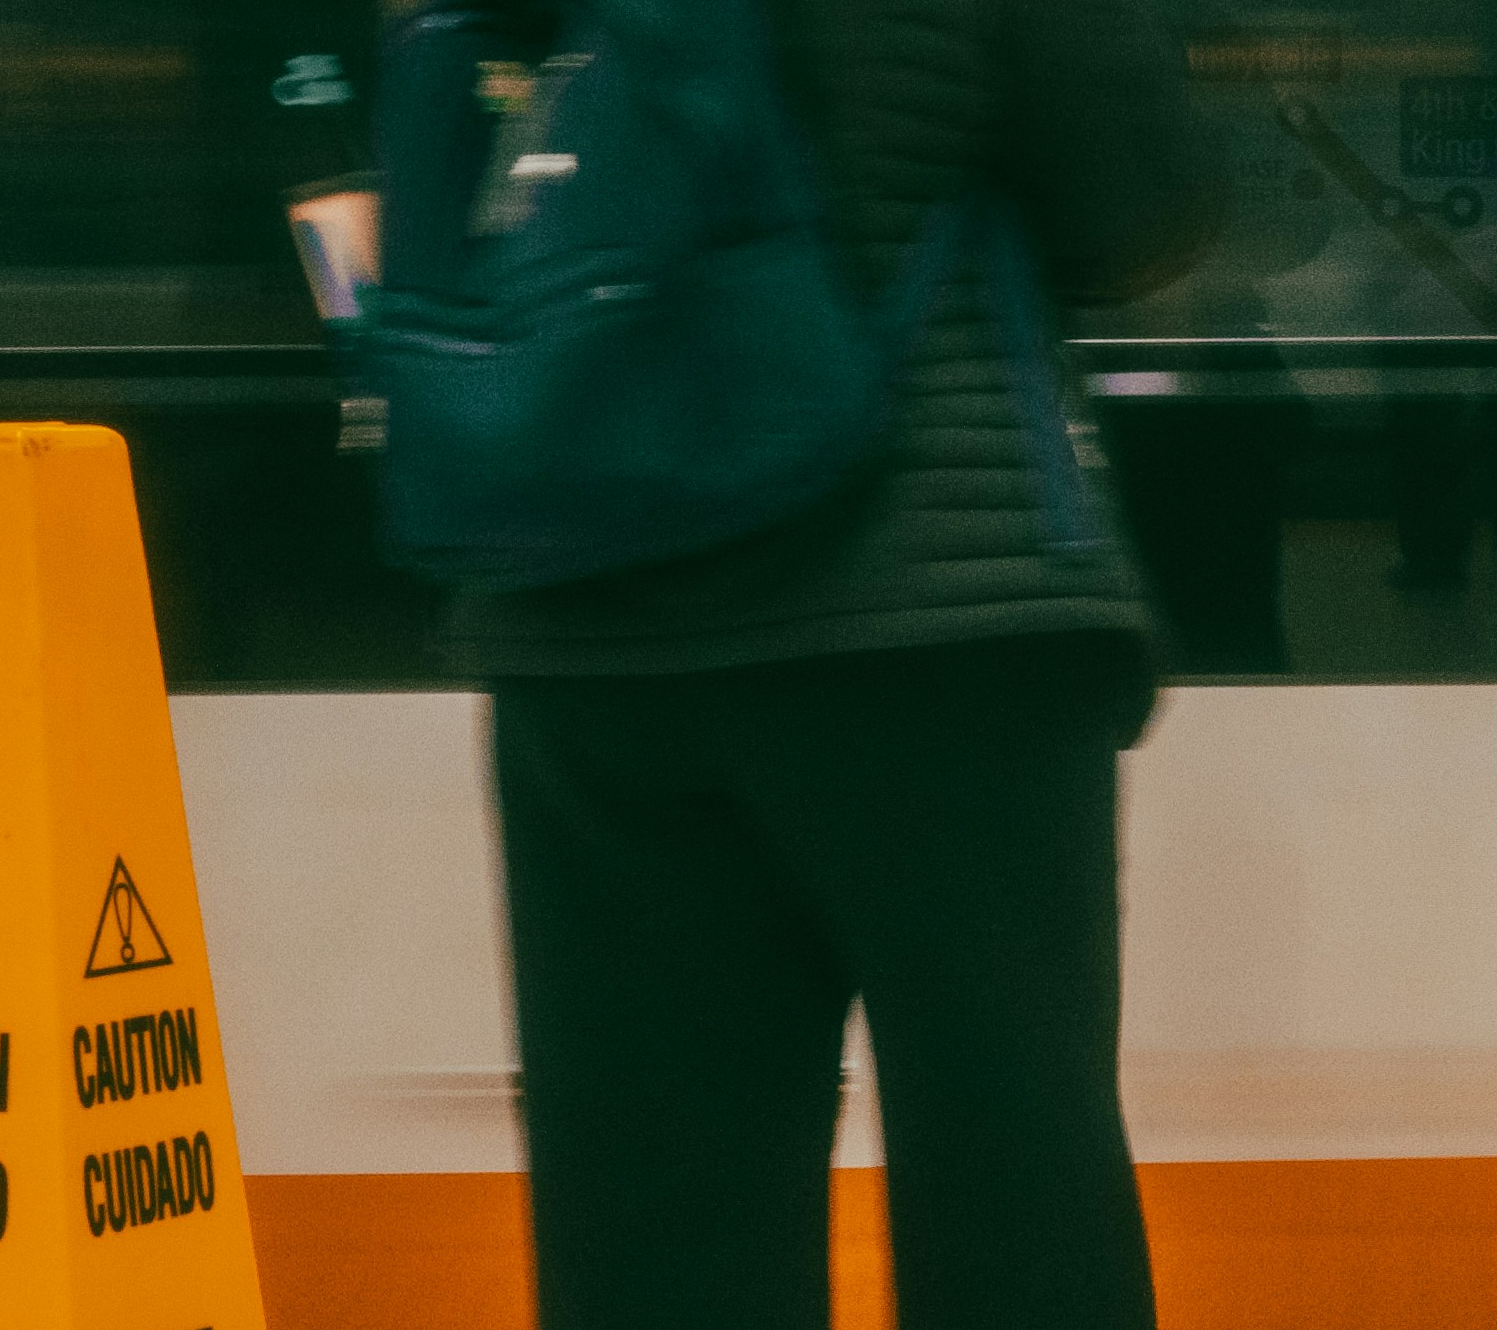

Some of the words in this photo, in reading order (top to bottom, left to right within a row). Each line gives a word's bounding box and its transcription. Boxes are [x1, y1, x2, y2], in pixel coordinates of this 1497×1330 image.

[1412, 127, 1486, 175] King
[73, 1008, 202, 1109] CAUTION
[83, 1131, 215, 1237] CUIDADO
